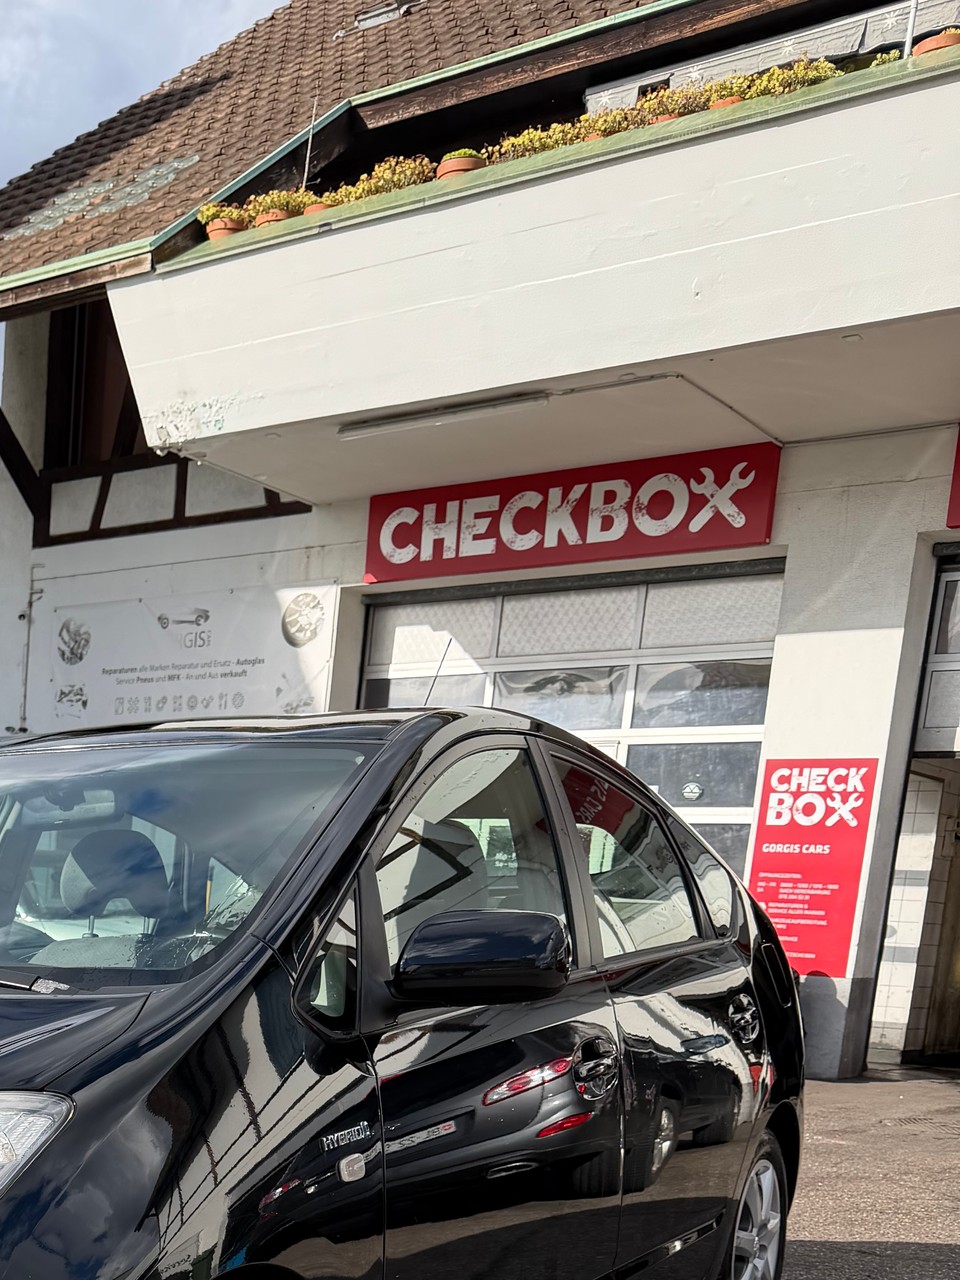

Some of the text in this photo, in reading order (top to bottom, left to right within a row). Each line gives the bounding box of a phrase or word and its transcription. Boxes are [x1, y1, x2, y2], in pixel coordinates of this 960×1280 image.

[379, 461, 756, 565] CHECKBOX
[102, 667, 137, 675] Reparaturen
[149, 664, 169, 672] Marken
[171, 663, 199, 671] Reparatur
[200, 660, 212, 669] und
[236, 657, 265, 667] Autoglas
[115, 677, 135, 685] Service
[155, 675, 166, 683] und
[167, 673, 181, 681] MFK
[194, 672, 206, 680] und
[220, 669, 248, 679] verkauft
[770, 767, 869, 792] CHECK
[765, 792, 864, 827] BOX
[762, 843, 830, 854] GORGIS CARS
